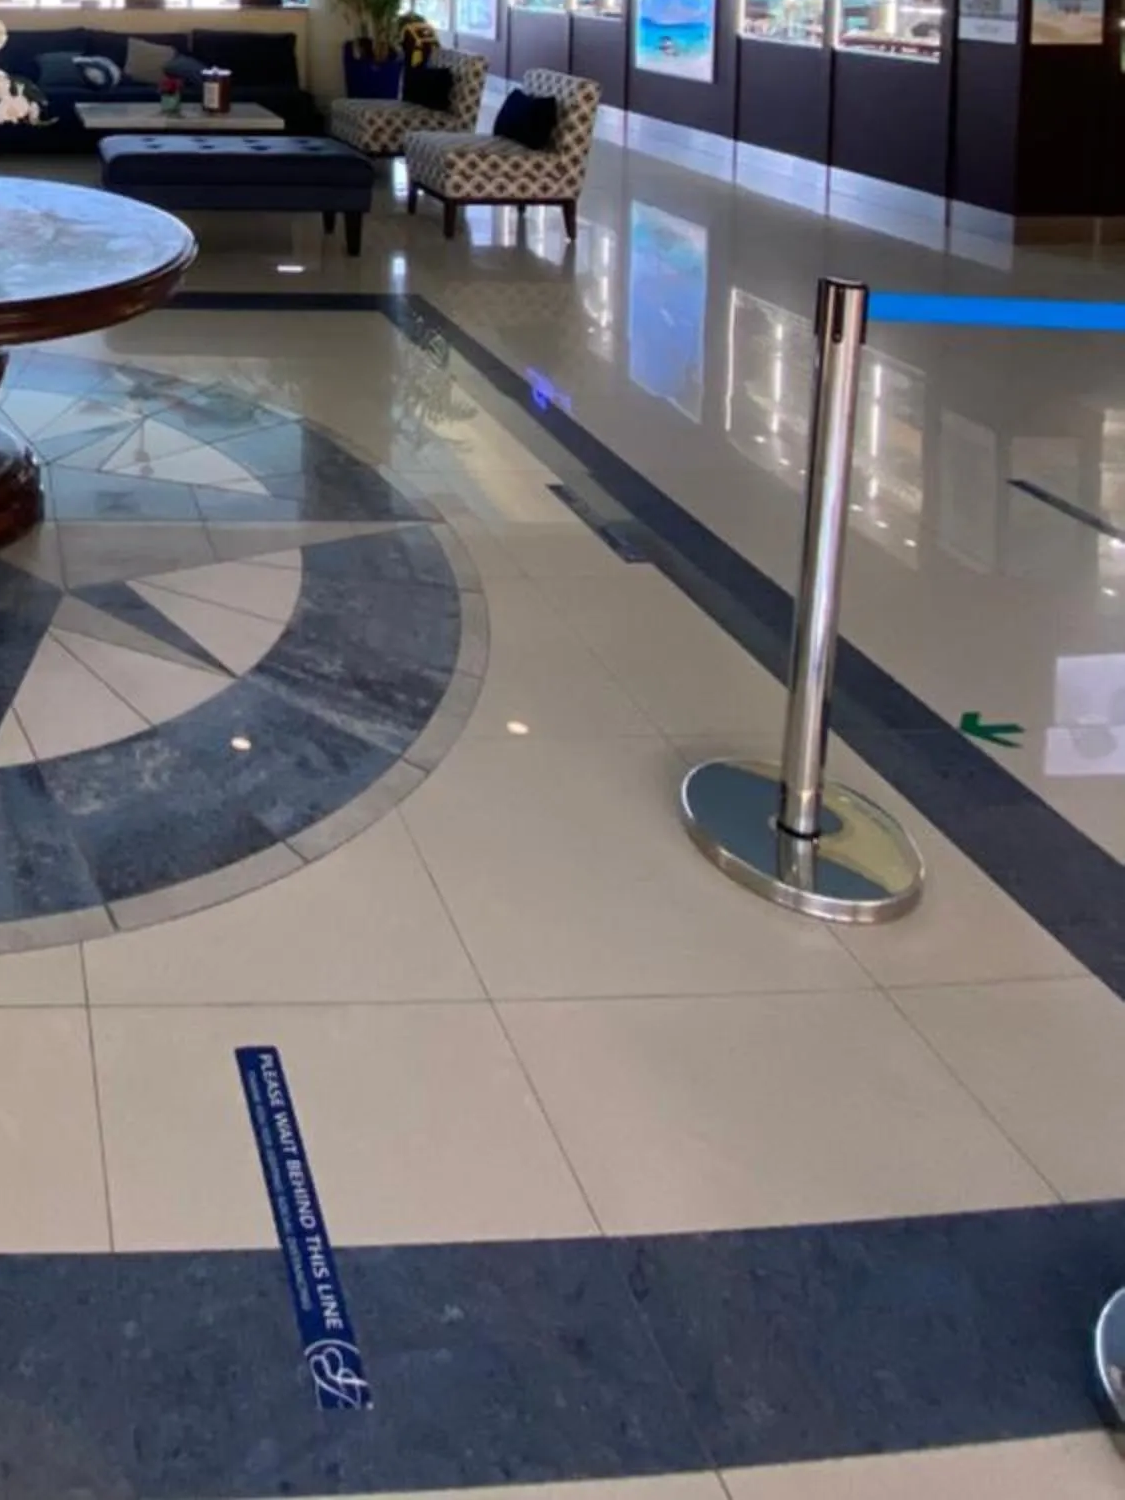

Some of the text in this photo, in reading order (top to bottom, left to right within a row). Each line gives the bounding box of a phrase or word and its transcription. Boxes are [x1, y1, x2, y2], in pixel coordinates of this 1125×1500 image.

[259, 1053, 286, 1107] PLEASE
[274, 1111, 299, 1155] WAIT
[286, 1159, 317, 1229] BEHIND
[305, 1235, 330, 1279] THIS
[316, 1283, 344, 1331] LINE
